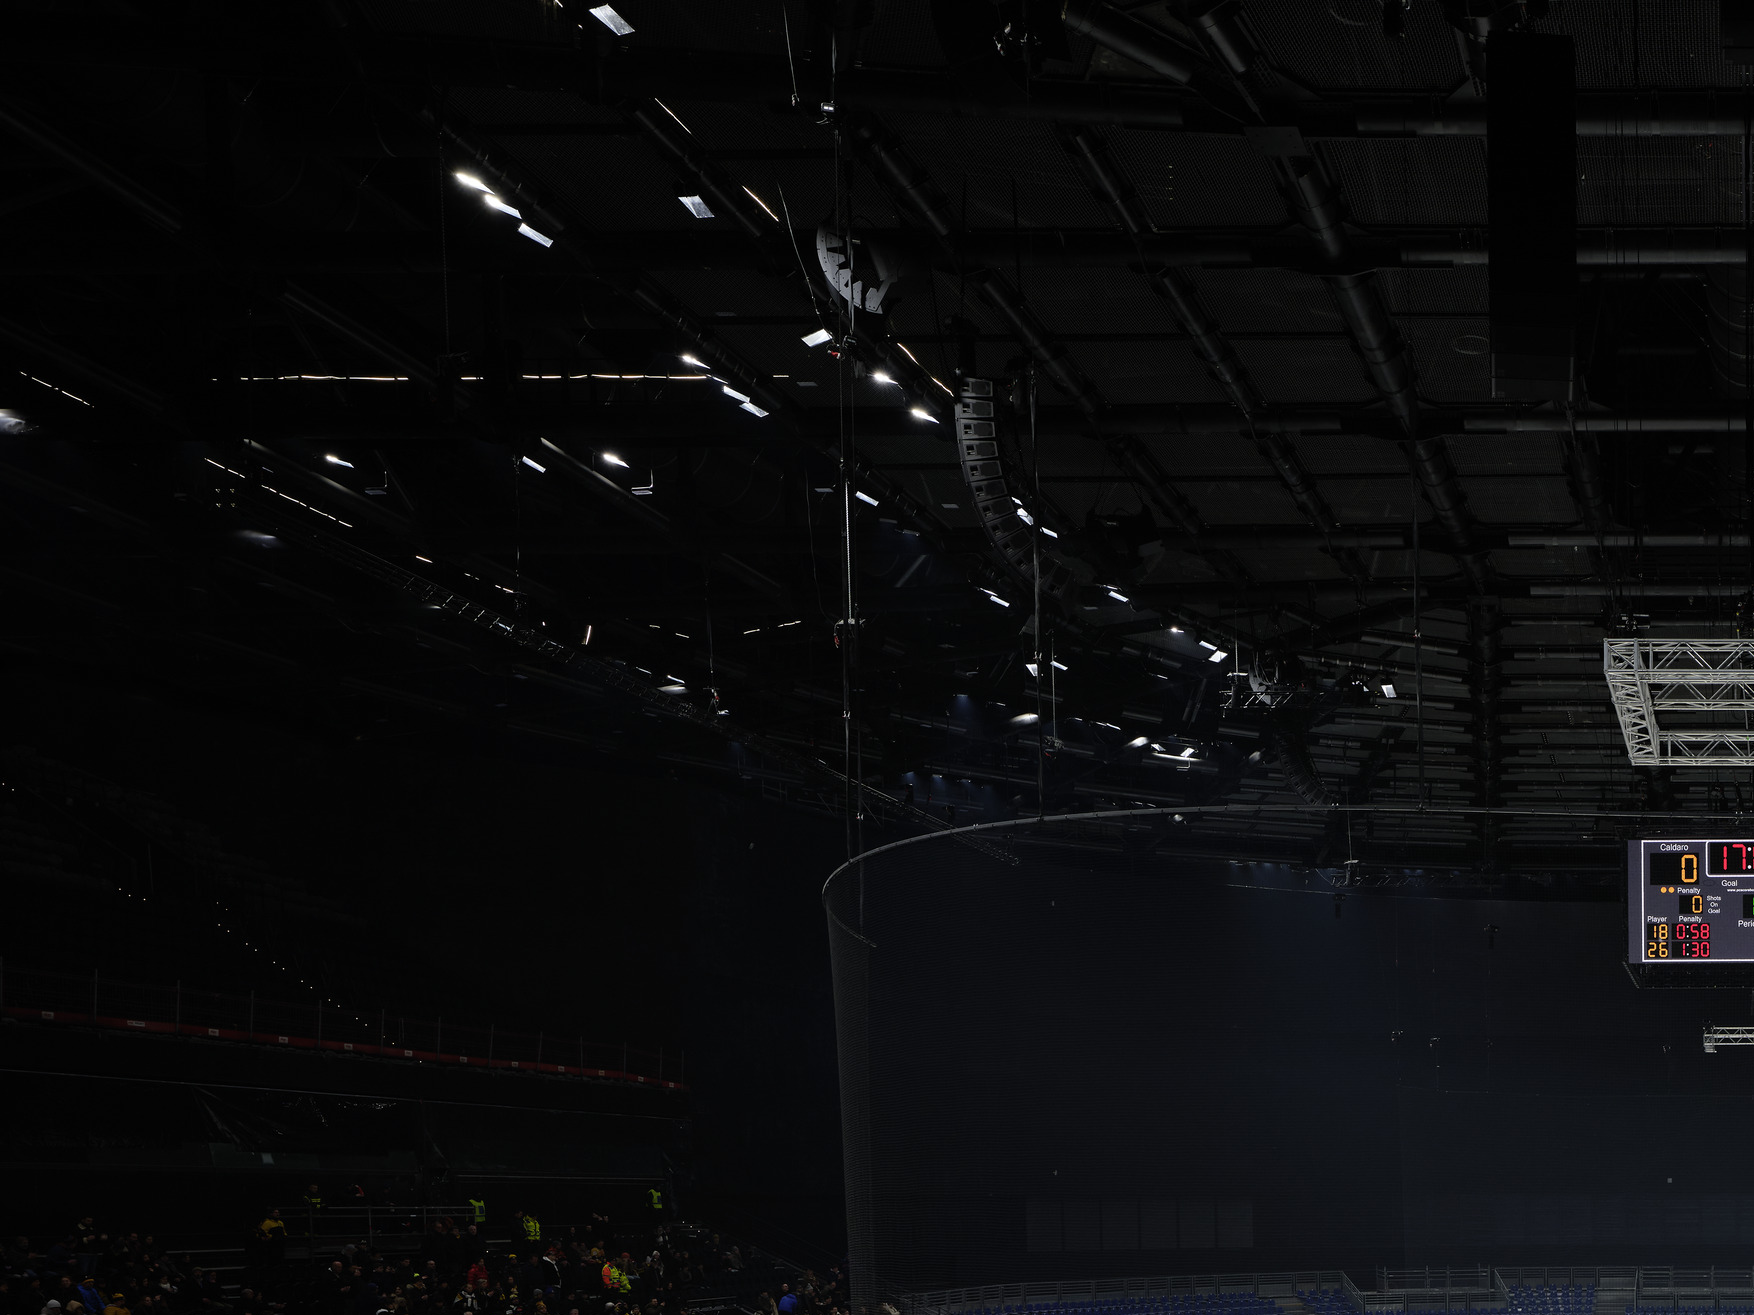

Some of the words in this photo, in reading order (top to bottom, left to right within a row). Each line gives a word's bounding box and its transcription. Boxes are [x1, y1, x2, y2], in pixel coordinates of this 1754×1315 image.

[1660, 843, 1689, 851] Caldaro
[1681, 854, 1697, 883] 0
[1677, 887, 1700, 895] Penalty
[1721, 879, 1738, 887] Goal
[1692, 895, 1703, 913] 0
[1679, 915, 1702, 923] Penalty
[1653, 924, 1668, 940] 18
[1676, 924, 1710, 940] 0:58
[1648, 942, 1668, 958] 26
[1682, 942, 1710, 958] 1:30
